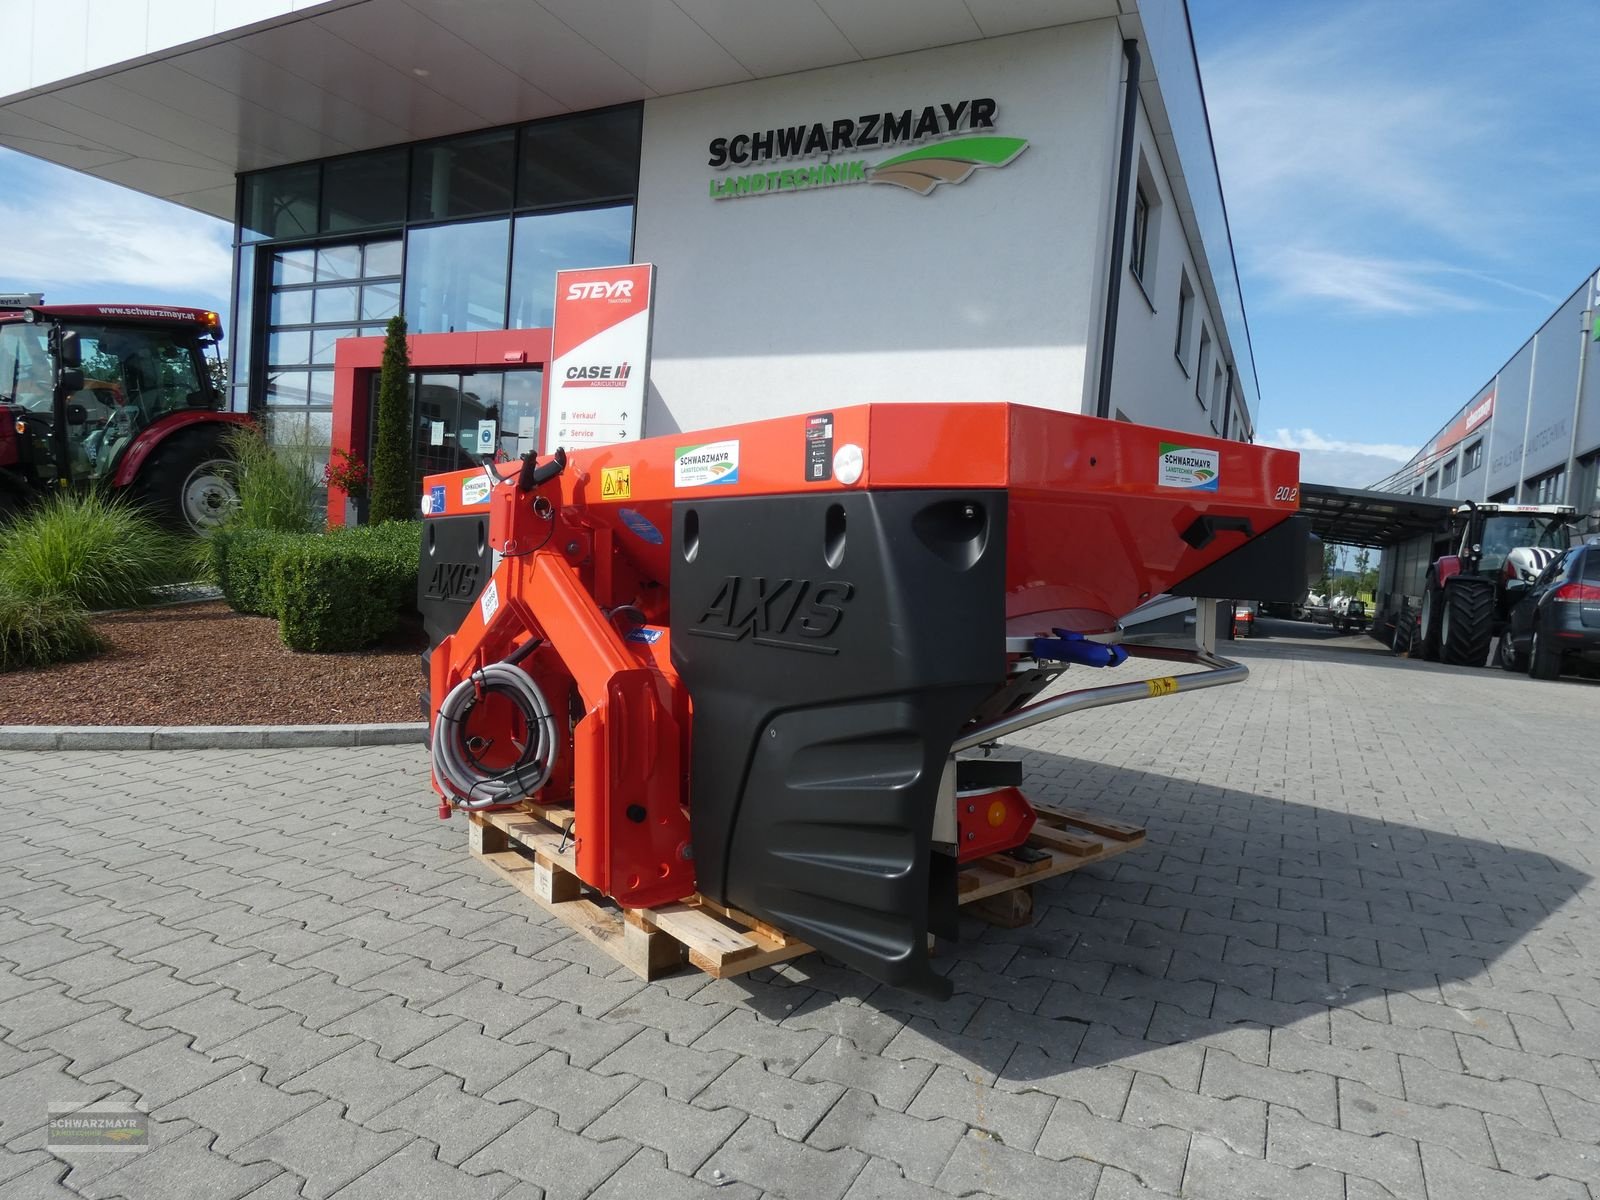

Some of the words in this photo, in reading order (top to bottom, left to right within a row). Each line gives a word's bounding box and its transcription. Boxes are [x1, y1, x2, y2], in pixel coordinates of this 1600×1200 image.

[708, 98, 998, 168] SCHWARZMAYR
[709, 159, 866, 198] LANDTECHNIK
[566, 279, 634, 301] STEYR
[98, 306, 196, 321] www.schwarzmayr.at
[566, 365, 613, 380] CASE
[590, 380, 626, 388] AGRICULTURE
[571, 411, 597, 420] Verkauf
[570, 429, 594, 438] Service
[680, 452, 729, 466] SCHWARZMAYR
[1164, 454, 1211, 469] SCHWARZMAYR
[1274, 486, 1298, 502] 20.2
[428, 562, 480, 599] AXIS
[692, 575, 856, 642] AXIS
